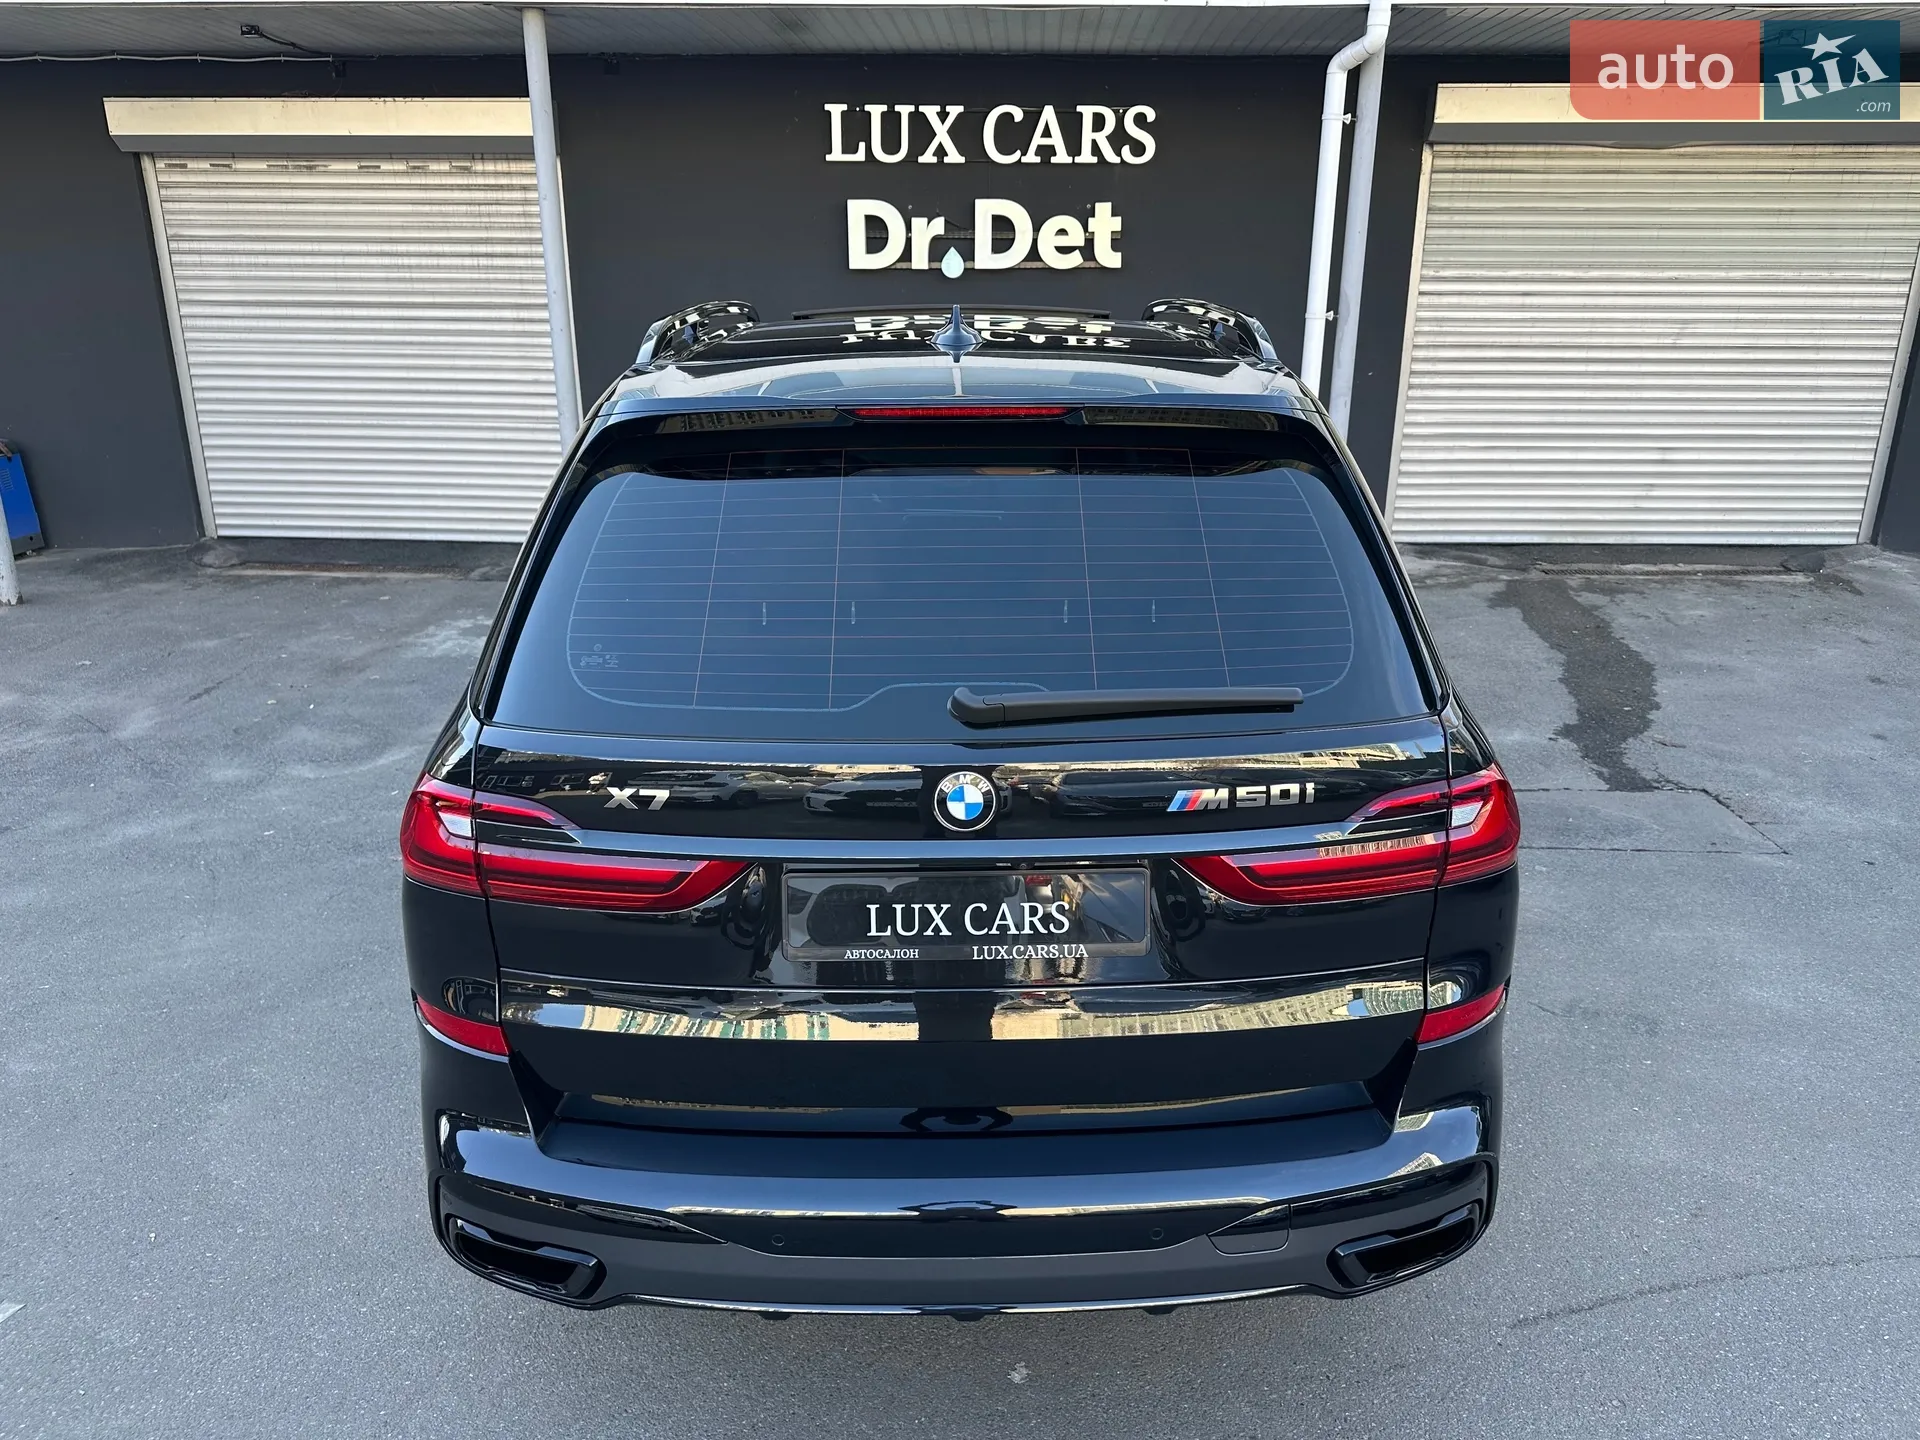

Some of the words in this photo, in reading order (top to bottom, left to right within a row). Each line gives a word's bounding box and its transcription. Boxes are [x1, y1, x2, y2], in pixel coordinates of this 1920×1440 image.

[824, 103, 966, 164] LUX
[982, 104, 1157, 165] CARS
[940, 774, 990, 794] BMW
[603, 786, 670, 811] X7
[866, 903, 952, 937] LUX
[964, 901, 1070, 936] CARS
[844, 948, 920, 960] АВТОСАЛОН
[972, 943, 1089, 961] LUX.CARS.UA
